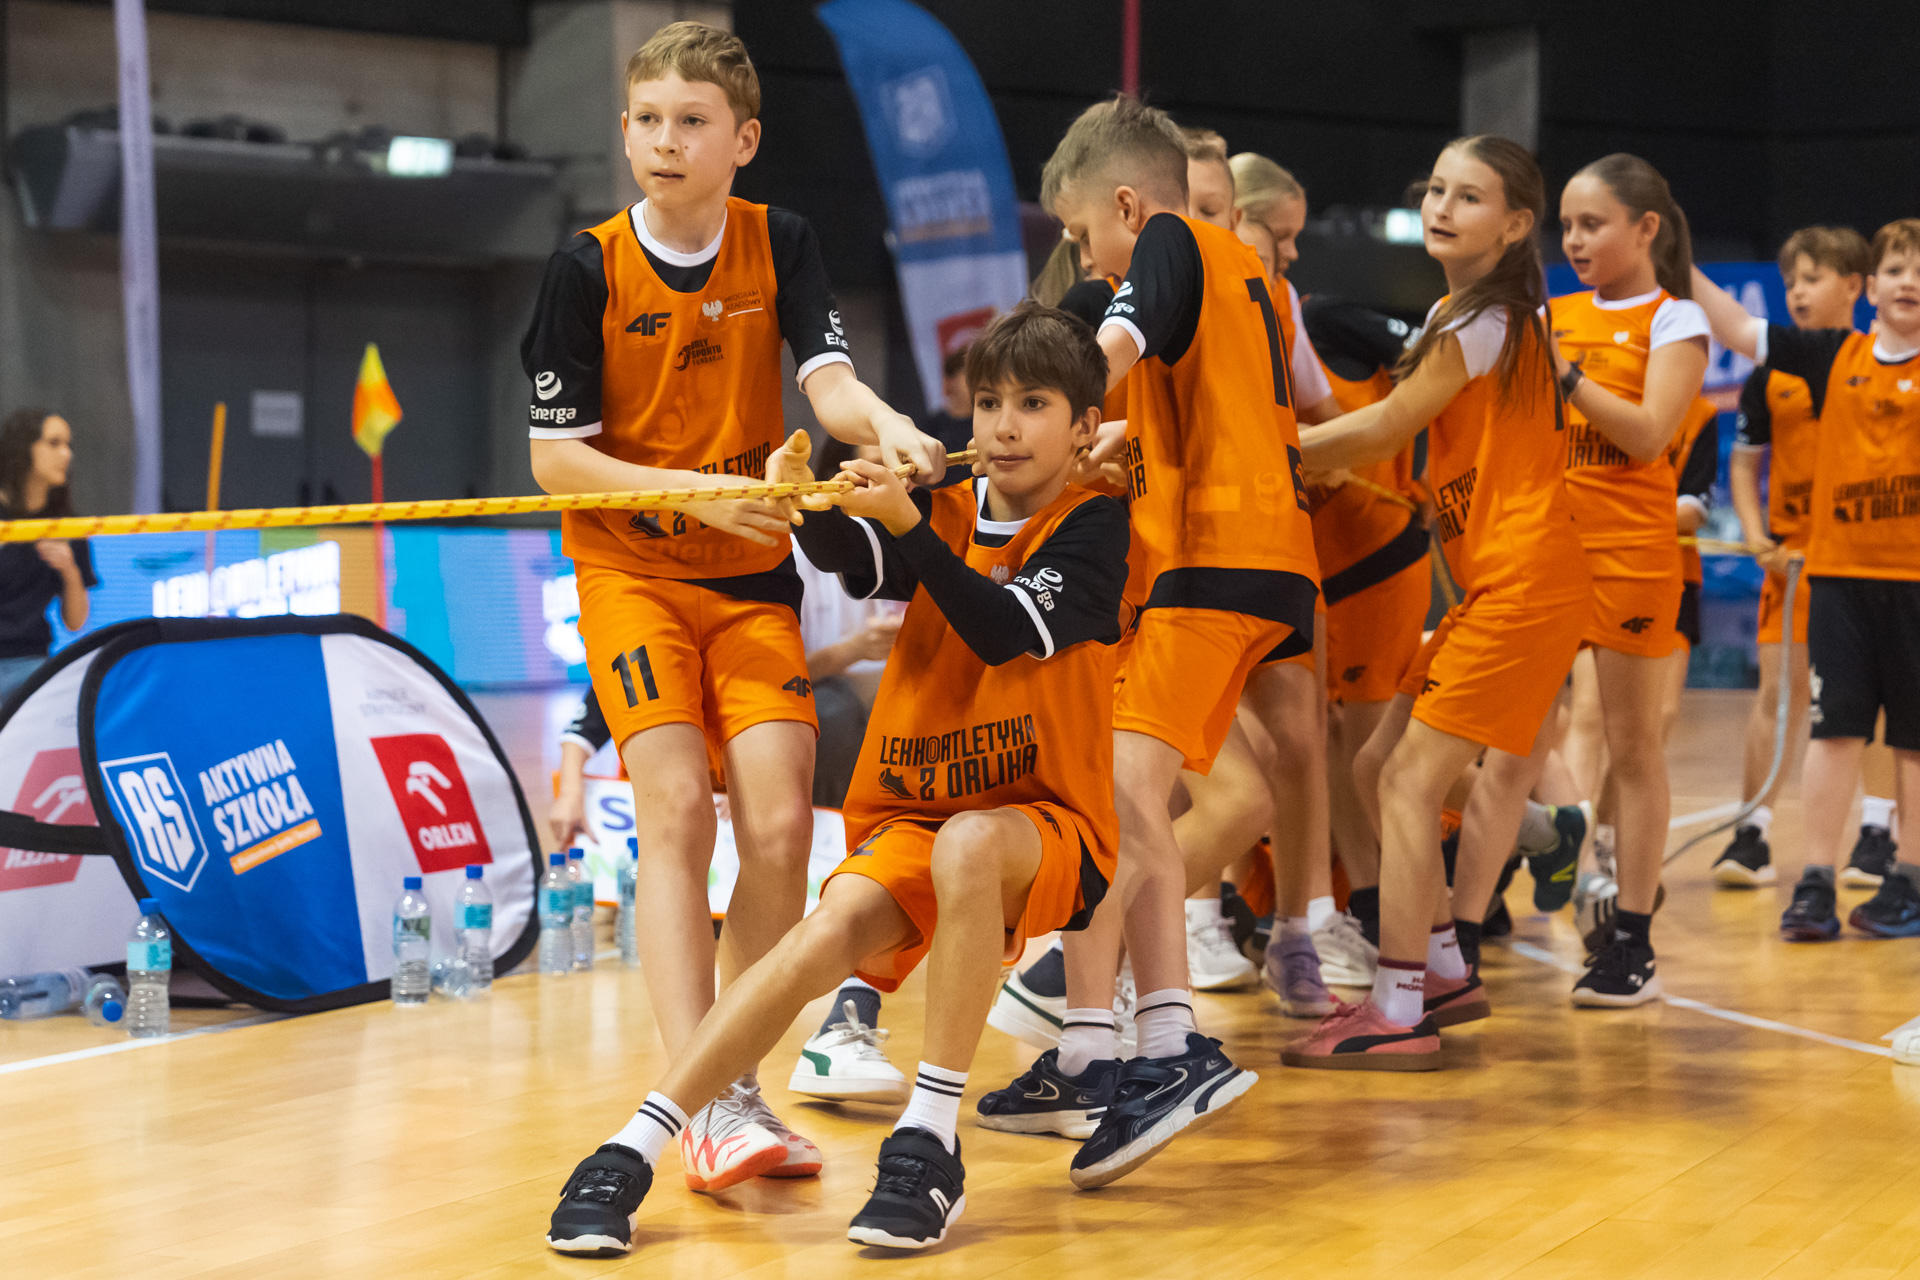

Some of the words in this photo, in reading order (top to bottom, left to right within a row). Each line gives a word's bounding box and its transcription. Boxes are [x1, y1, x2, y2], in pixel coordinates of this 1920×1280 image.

[625, 312, 672, 336] 4F
[691, 345, 722, 359] SPORTU
[530, 404, 577, 424] Energa
[611, 645, 660, 709] 11
[199, 739, 297, 807] AKTYWNA
[947, 743, 1039, 799] ORLIKA
[213, 774, 315, 853] SZKOŁA
[419, 821, 477, 851] ORLEN
